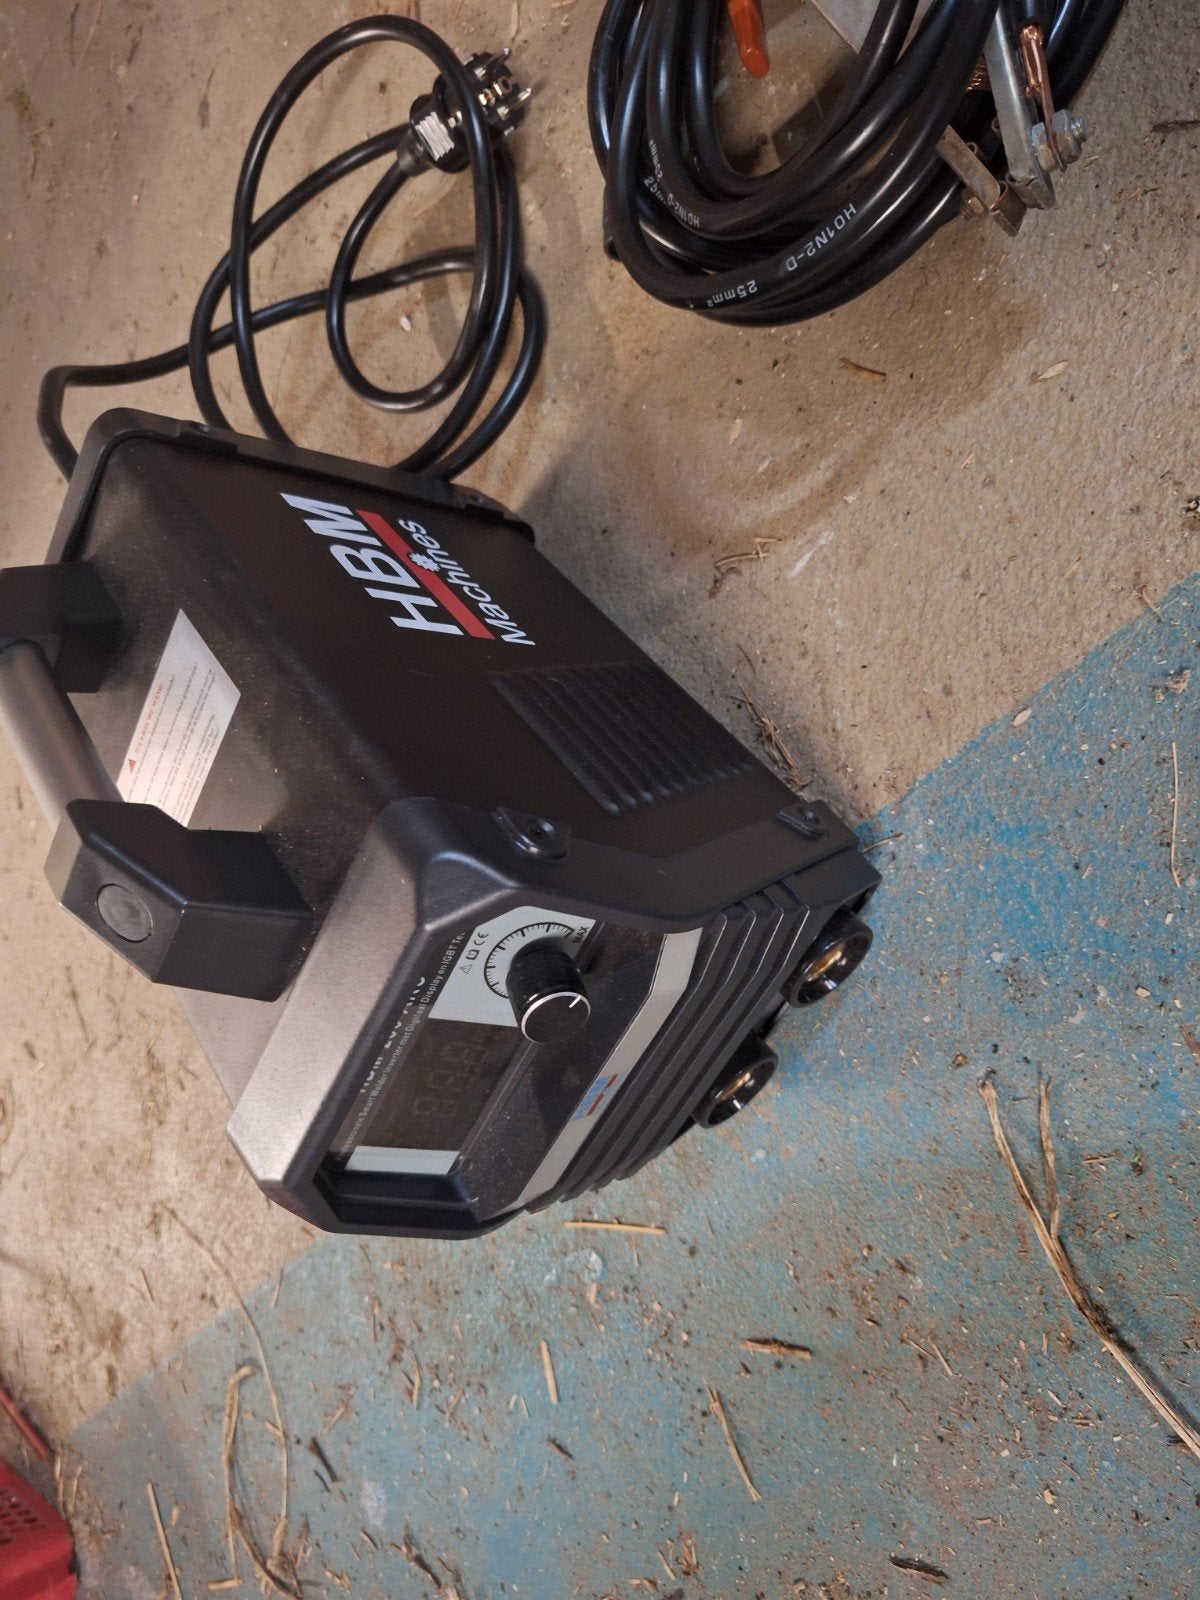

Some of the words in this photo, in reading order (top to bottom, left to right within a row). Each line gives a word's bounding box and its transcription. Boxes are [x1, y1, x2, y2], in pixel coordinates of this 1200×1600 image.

[280, 492, 465, 636] HBM
[398, 518, 536, 646] Machines
[571, 926, 589, 944] MAX
[441, 945, 458, 965] IGBT
[438, 962, 448, 975] en
[421, 975, 444, 1003] Display
[405, 1004, 427, 1033] Digitaal
[382, 1045, 404, 1074] Inverter
[370, 1073, 388, 1098] Welder
[359, 1096, 376, 1117] Smart
